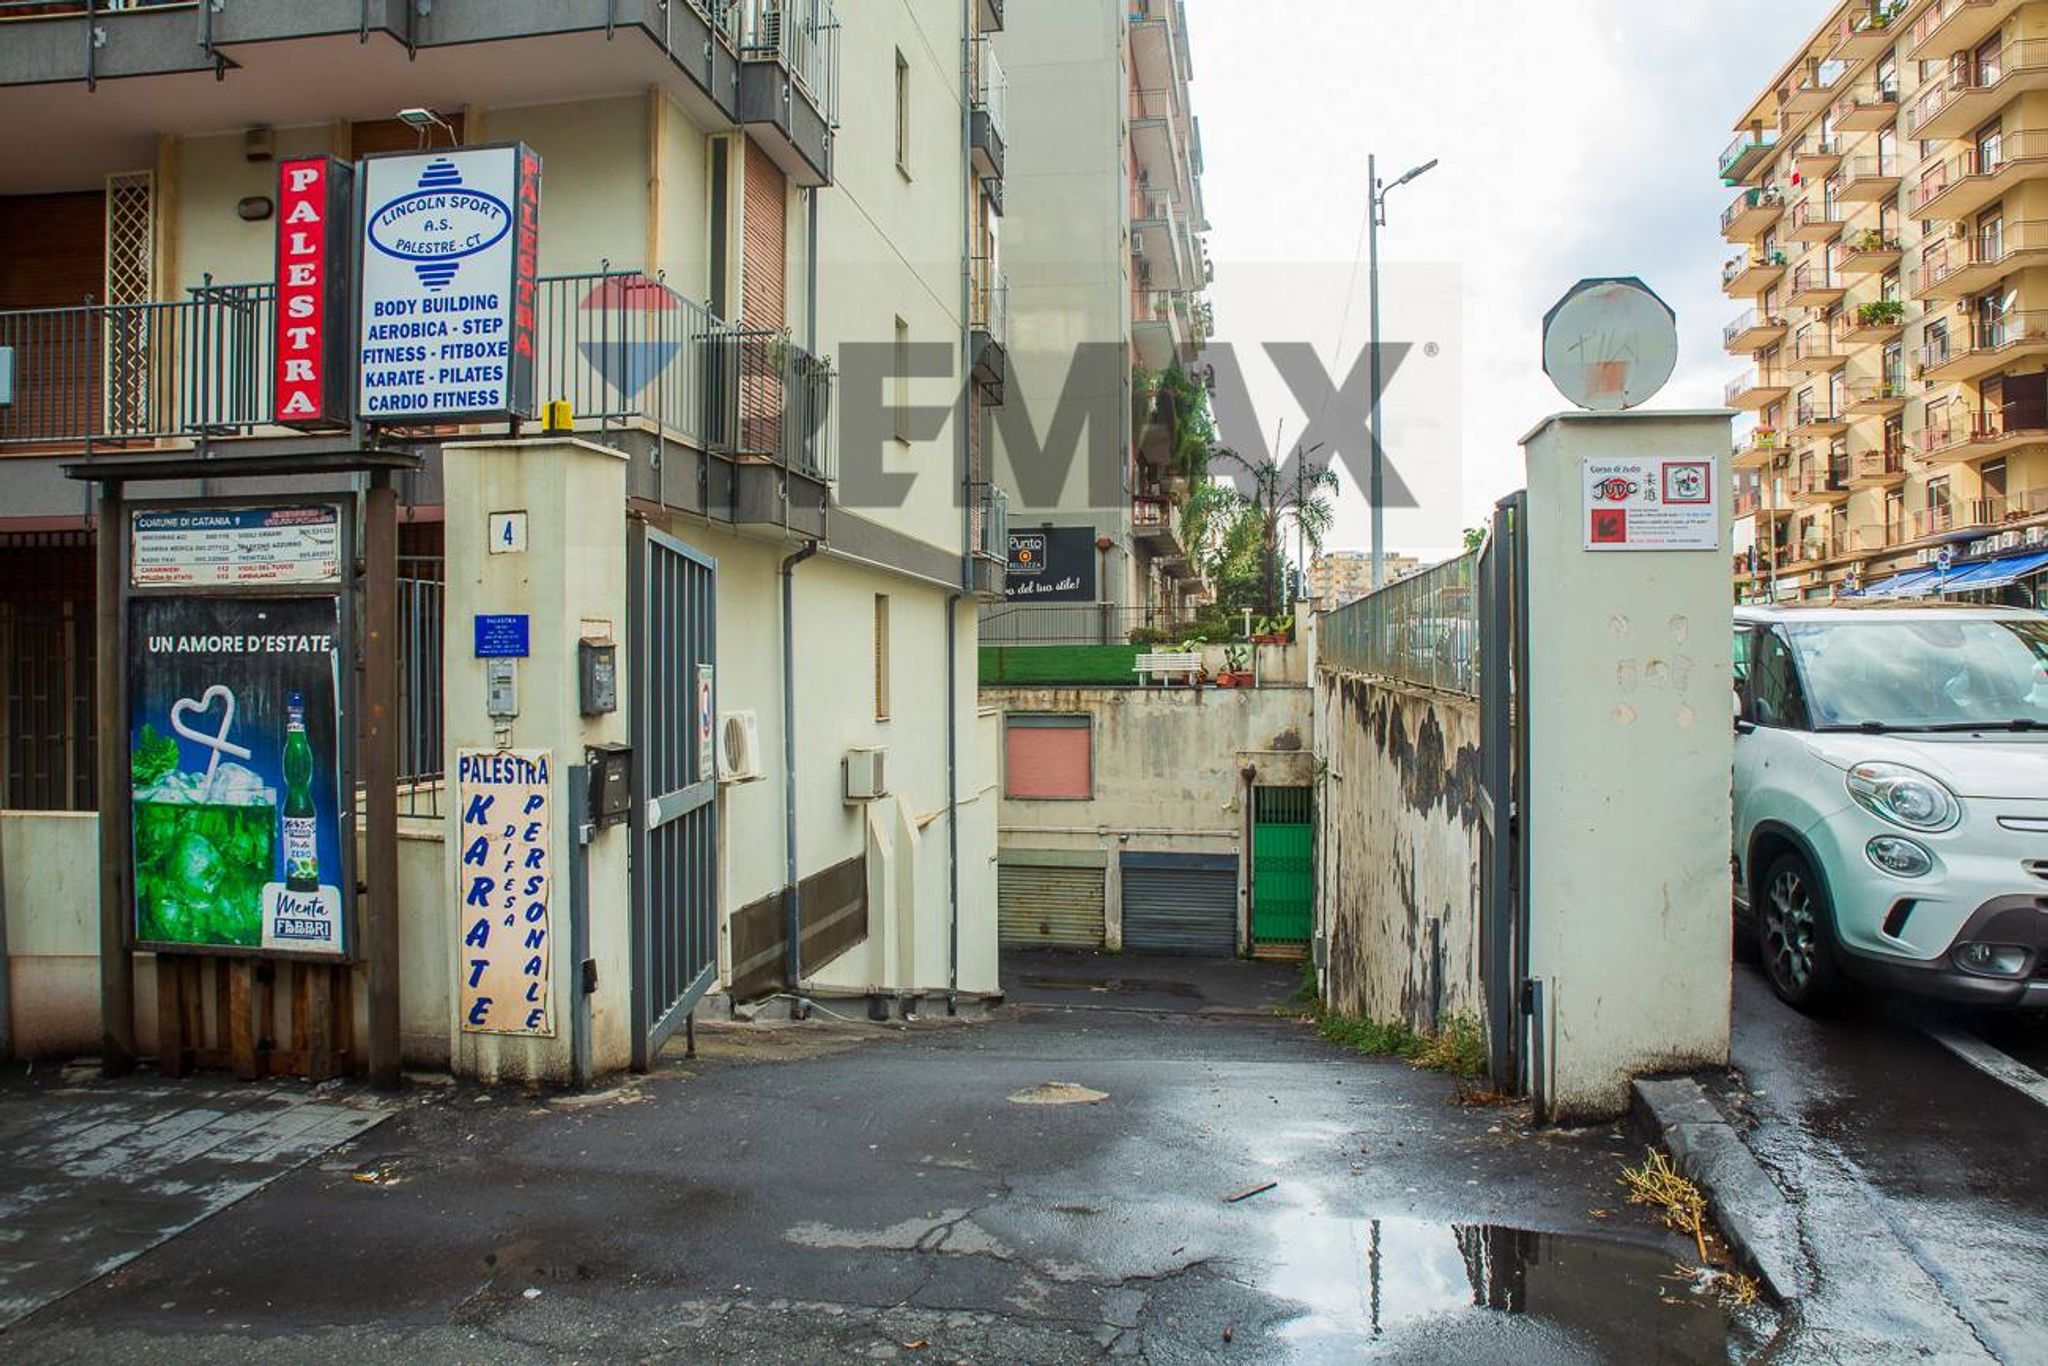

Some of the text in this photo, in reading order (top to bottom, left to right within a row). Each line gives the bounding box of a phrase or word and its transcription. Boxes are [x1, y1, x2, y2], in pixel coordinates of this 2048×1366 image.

[382, 196, 501, 226] LINCOLN SPORT
[424, 219, 453, 232] A.S.
[396, 239, 456, 254] PALESTRE
[466, 233, 481, 247] CT
[515, 155, 538, 358] PALESTRA
[283, 168, 319, 413] PALESTRA
[374, 294, 499, 316] BODY BUILDING
[368, 320, 448, 341] AEROBICA
[463, 318, 504, 335] STEP
[363, 346, 427, 364] FITNESS
[441, 341, 508, 360] FITBOXE
[366, 370, 425, 388] KARATE
[439, 365, 504, 384] PILATES
[368, 390, 499, 411] CARDIO FITNESS
[140, 516, 231, 527] COMUNE DI CATANIA
[503, 520, 513, 545] 4
[1009, 536, 1043, 550] Punto
[1018, 580, 1034, 595] del
[1055, 576, 1080, 591] stile!
[149, 635, 331, 653] UN AMORE D'ESTATE
[459, 757, 548, 784] PALESTRA
[503, 824, 516, 927] DIFESA
[277, 891, 329, 917] Menta
[464, 794, 495, 1026] KARATE
[523, 794, 545, 1028] PERSONALE
[277, 919, 329, 937] FABBRI
